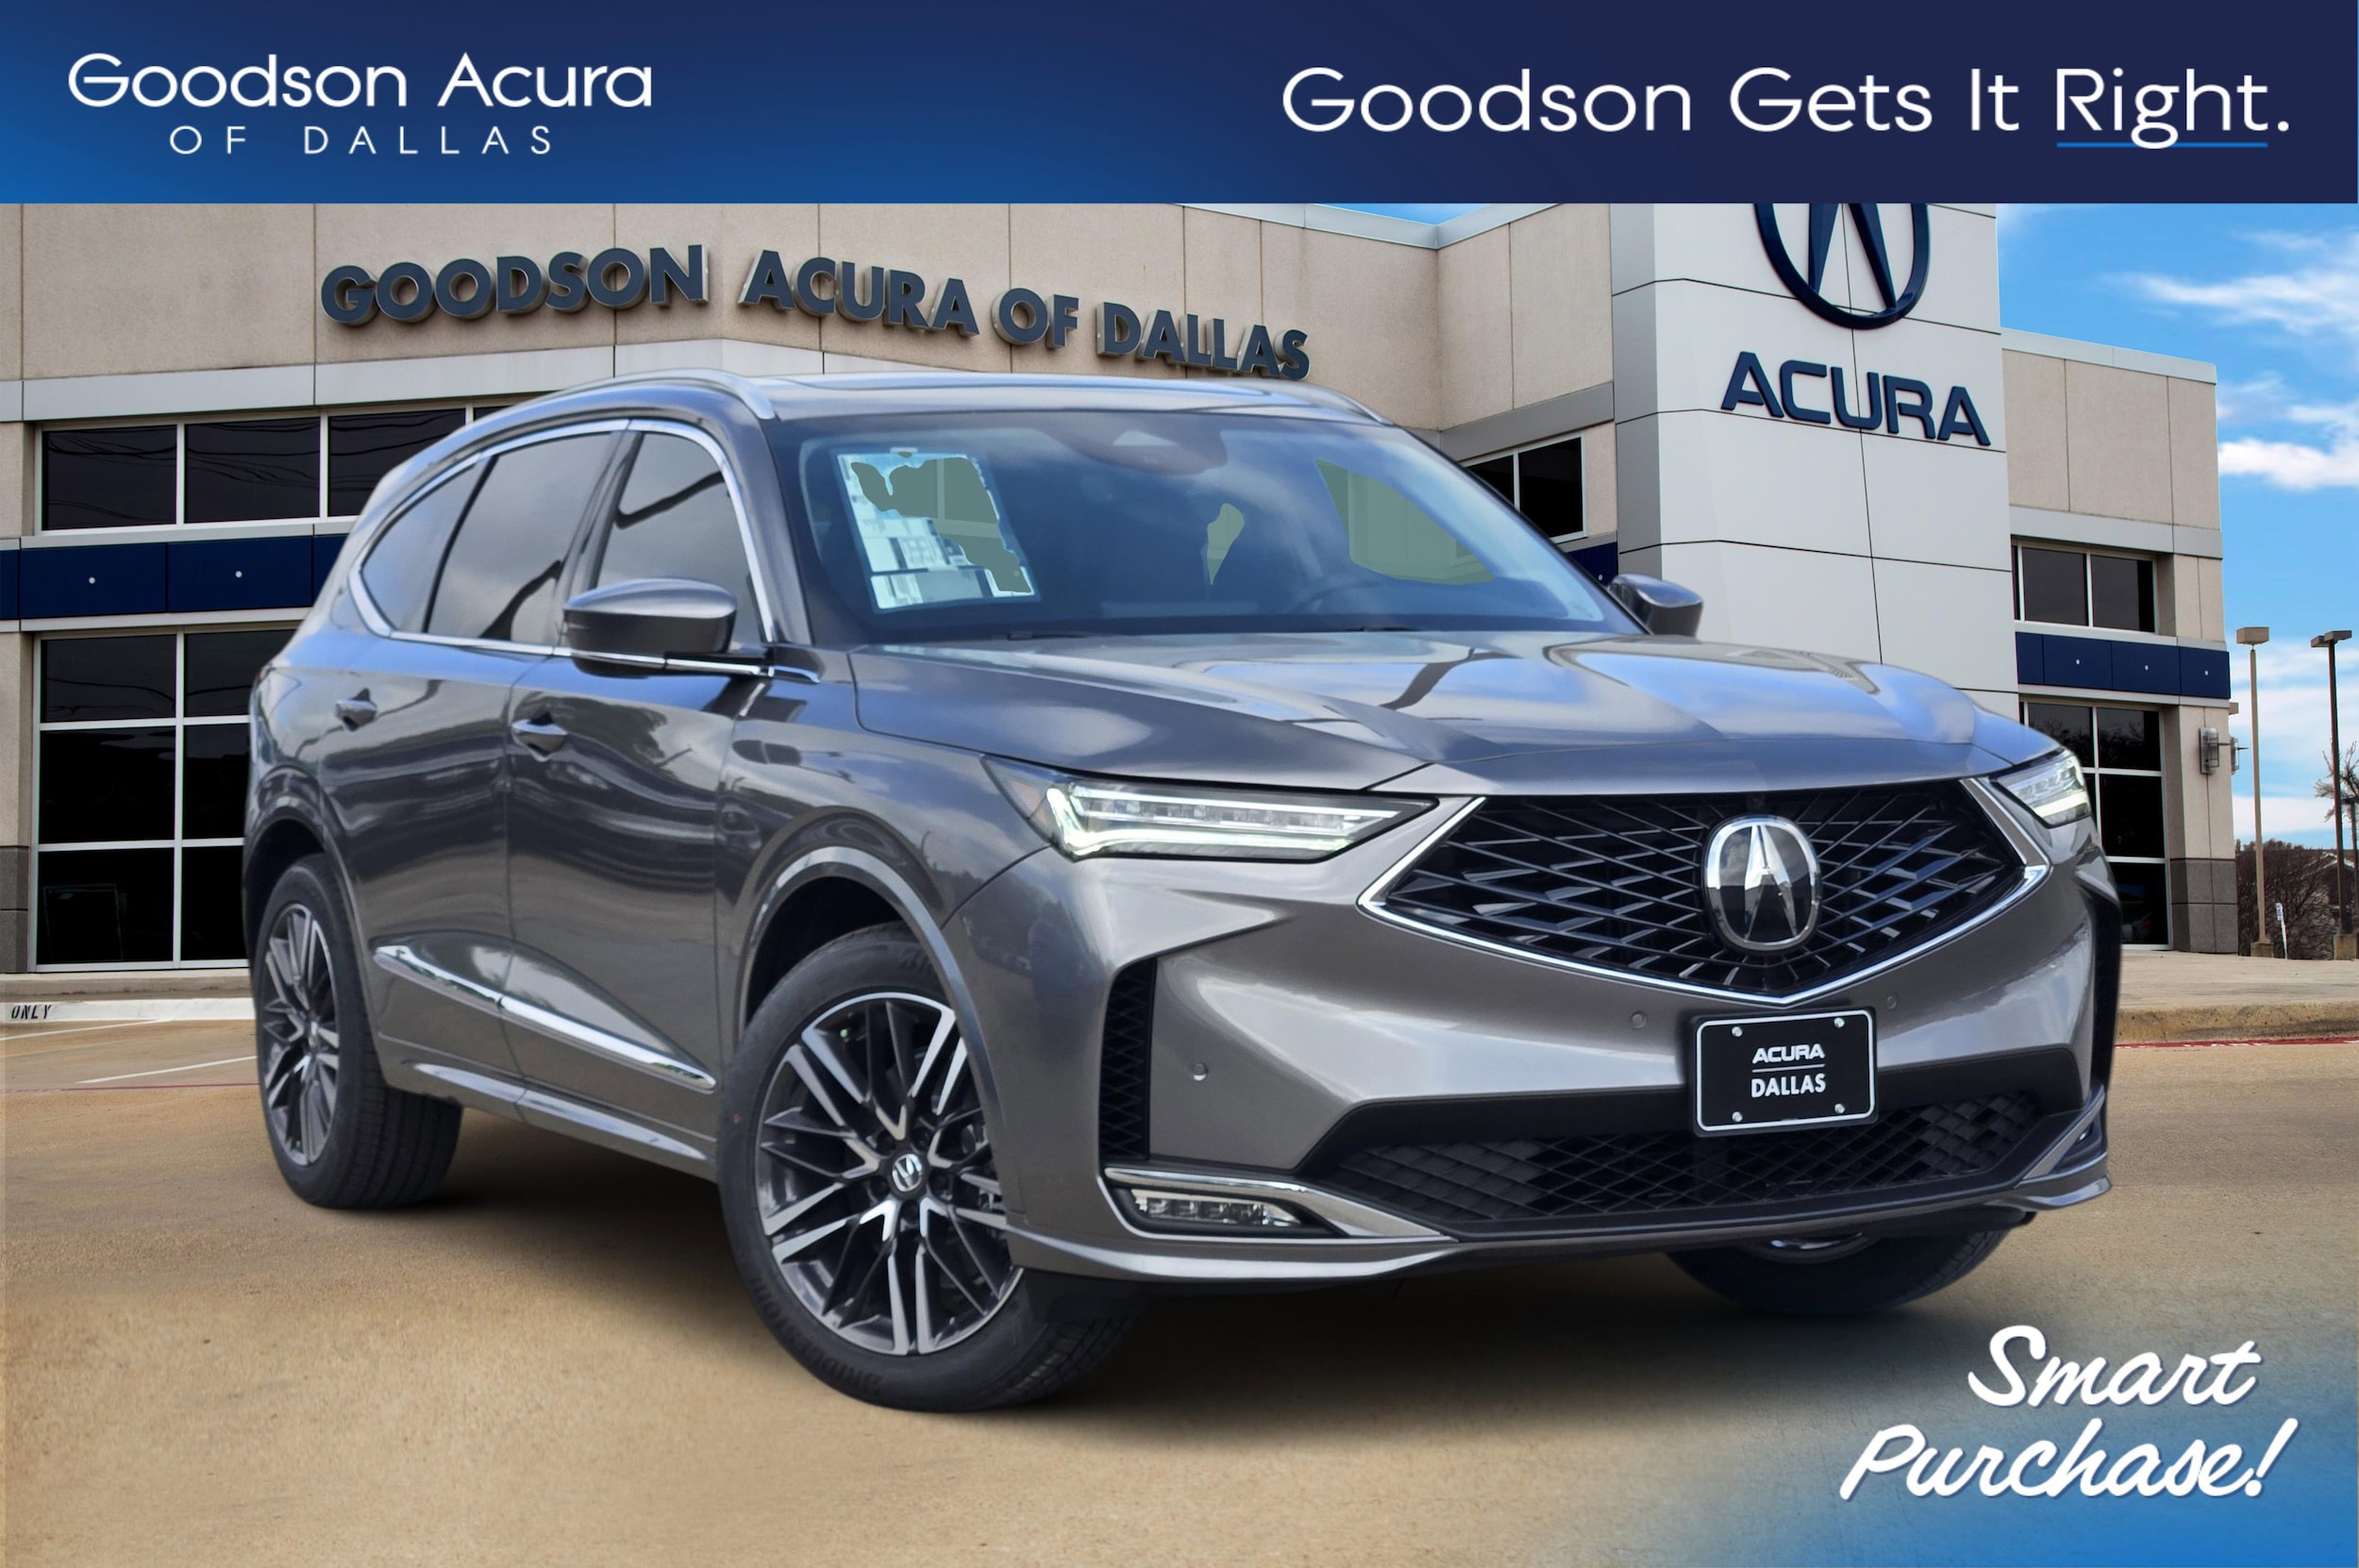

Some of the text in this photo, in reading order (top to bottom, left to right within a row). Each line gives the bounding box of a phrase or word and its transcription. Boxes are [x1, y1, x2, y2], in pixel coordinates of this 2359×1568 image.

[321, 244, 1312, 379] GOODSON ACURA OF DALLAS
[1720, 350, 1991, 446] ACURA
[10, 1004, 52, 1020] ONLY
[1752, 1043, 1826, 1064] ACURA
[1750, 1073, 1827, 1098] DALLAS
